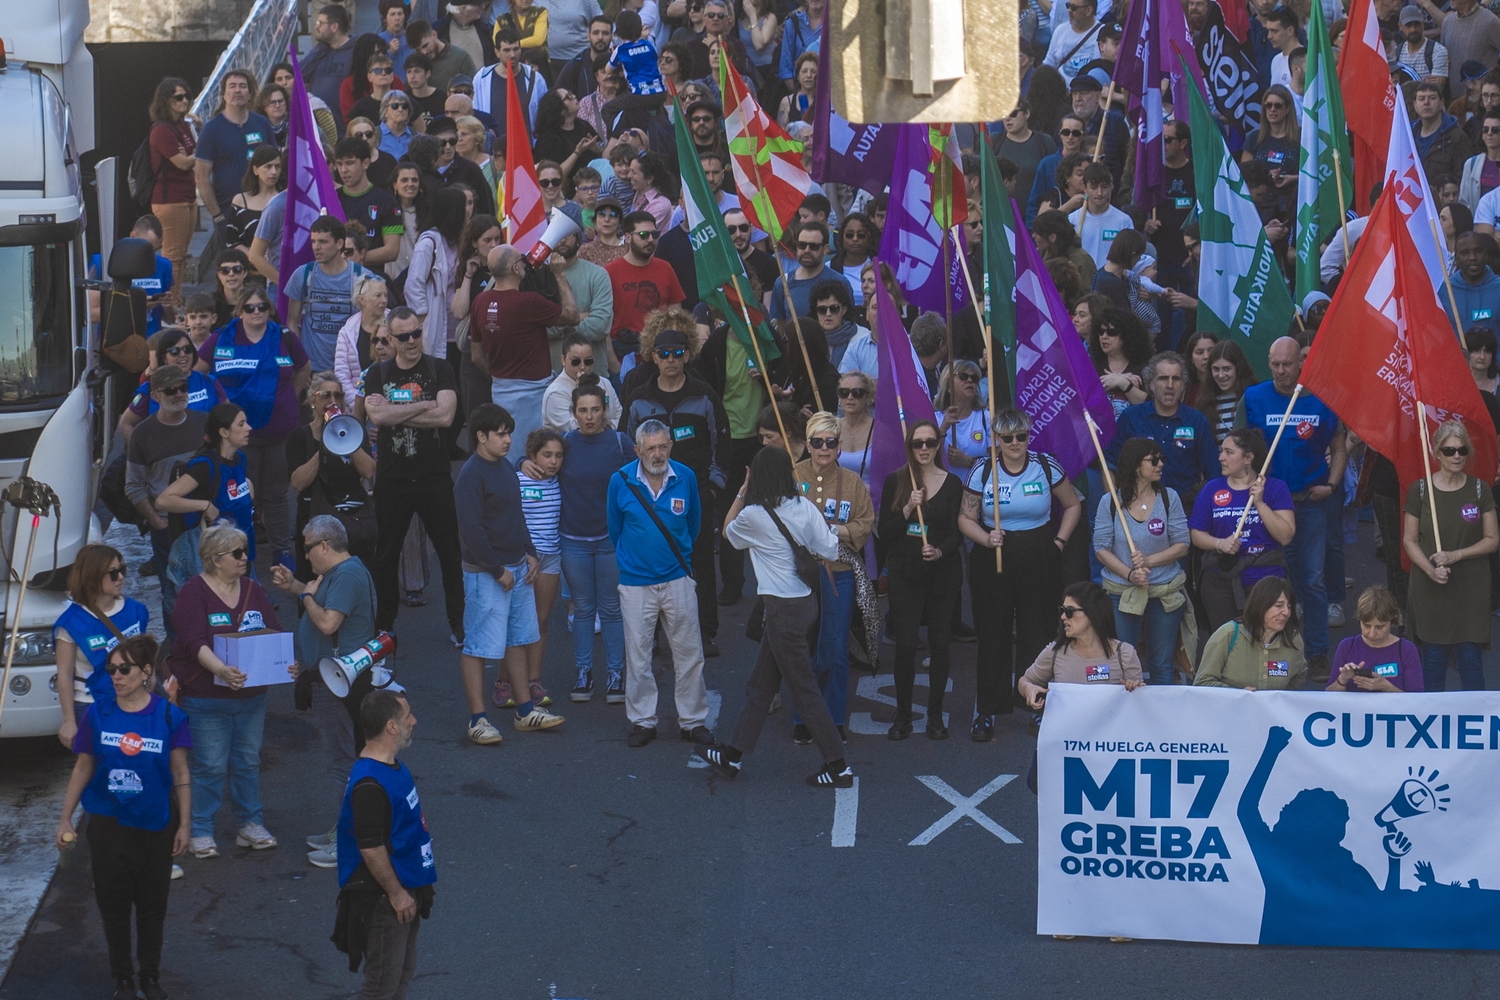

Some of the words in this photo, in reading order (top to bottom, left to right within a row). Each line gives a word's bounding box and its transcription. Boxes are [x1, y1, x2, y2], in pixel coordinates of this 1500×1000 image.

[676, 428, 692, 437] ELA
[1024, 485, 1041, 493] ELA
[525, 490, 541, 498] ELA
[1214, 492, 1230, 500] LAB
[1463, 507, 1479, 515] LAB
[1150, 521, 1164, 529] LAB
[211, 616, 229, 624] ELA
[88, 636, 107, 648] ELA
[1377, 667, 1396, 676] ELA
[122, 736, 143, 748] LAB
[1064, 740, 1091, 752] 17M
[1095, 742, 1155, 753] HUELGA
[1159, 743, 1228, 753] GENERAL
[1064, 757, 1229, 819] M17
[1061, 822, 1231, 859] GREBA
[1060, 856, 1230, 883] OROKORRA
